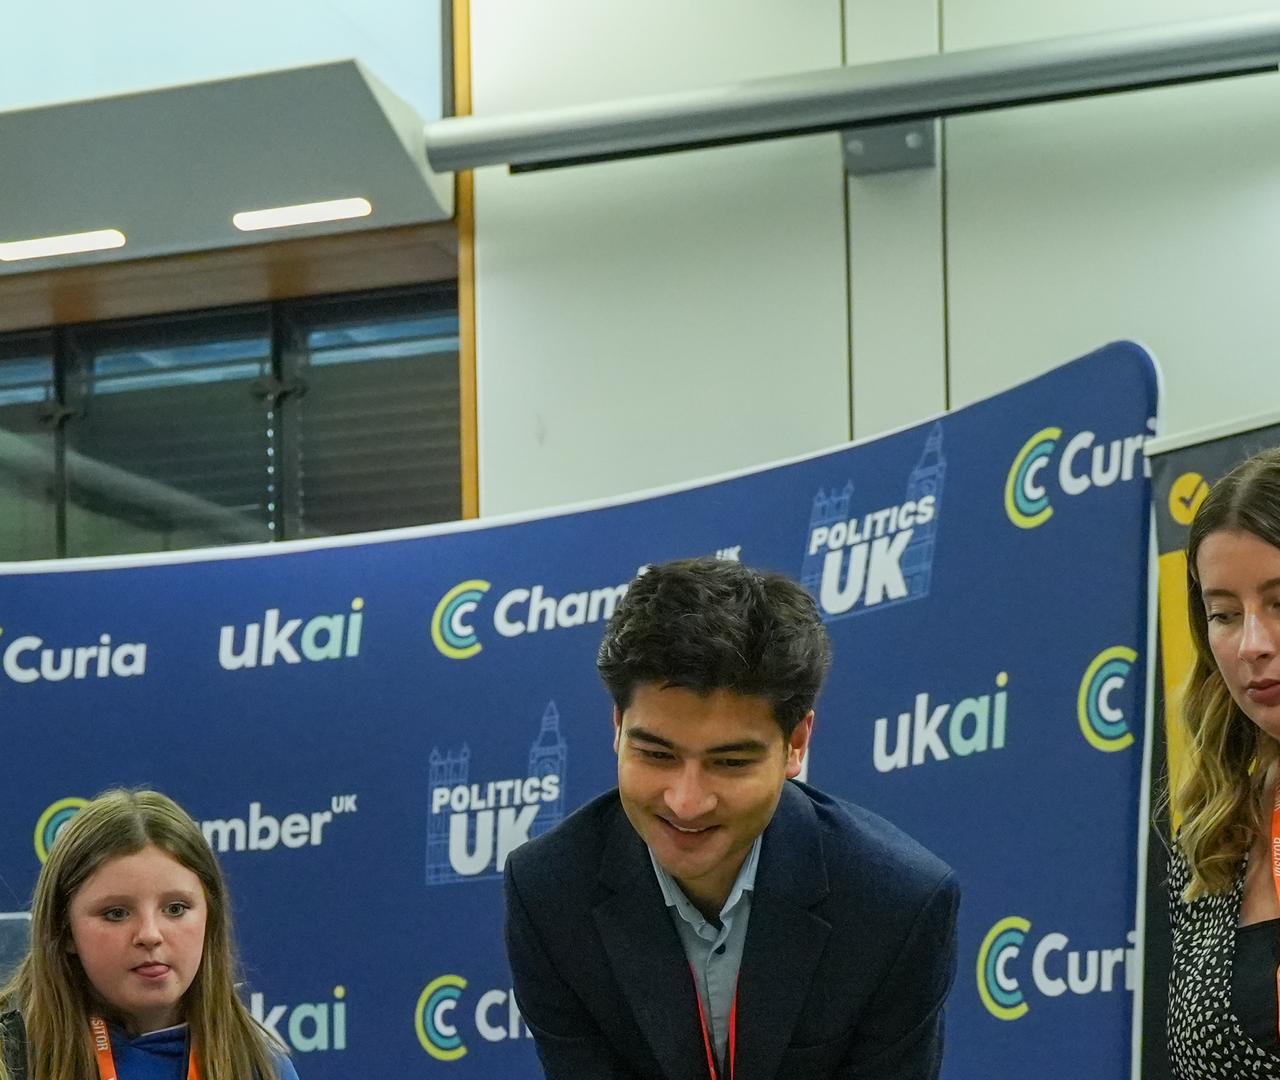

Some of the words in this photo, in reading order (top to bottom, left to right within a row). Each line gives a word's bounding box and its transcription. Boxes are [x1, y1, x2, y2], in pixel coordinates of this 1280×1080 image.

[809, 495, 936, 556] POLITICS
[820, 528, 913, 615] UK
[220, 597, 364, 671] ukai
[493, 583, 631, 637] Cham
[3, 633, 147, 683] Curia
[873, 672, 1009, 773] ukai
[432, 774, 560, 815] POLITICS
[198, 802, 332, 852] mber
[449, 804, 541, 876] UK
[90, 1016, 109, 1051] SITOR
[250, 984, 347, 1053] kai
